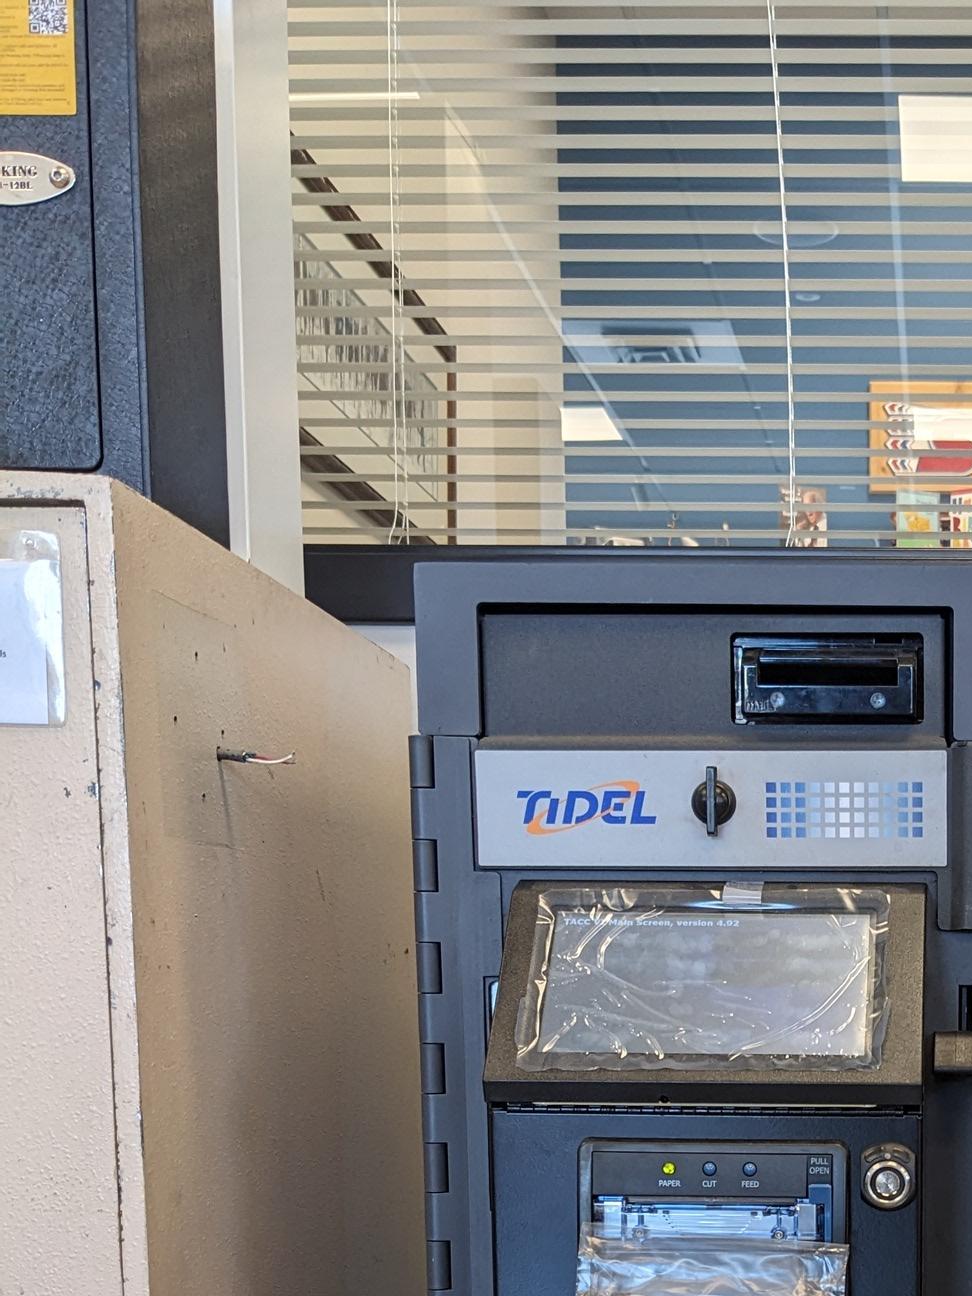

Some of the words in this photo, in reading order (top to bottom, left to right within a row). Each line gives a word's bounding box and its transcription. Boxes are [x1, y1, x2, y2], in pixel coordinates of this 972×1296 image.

[516, 789, 658, 826] TIDEL
[636, 918, 674, 929] Screen,
[676, 918, 714, 927] version
[810, 1157, 829, 1165] PULL
[809, 1166, 830, 1175] OPEN
[658, 1179, 681, 1188] PAPER
[702, 1180, 718, 1188] CUT
[741, 1180, 760, 1188] FEED
